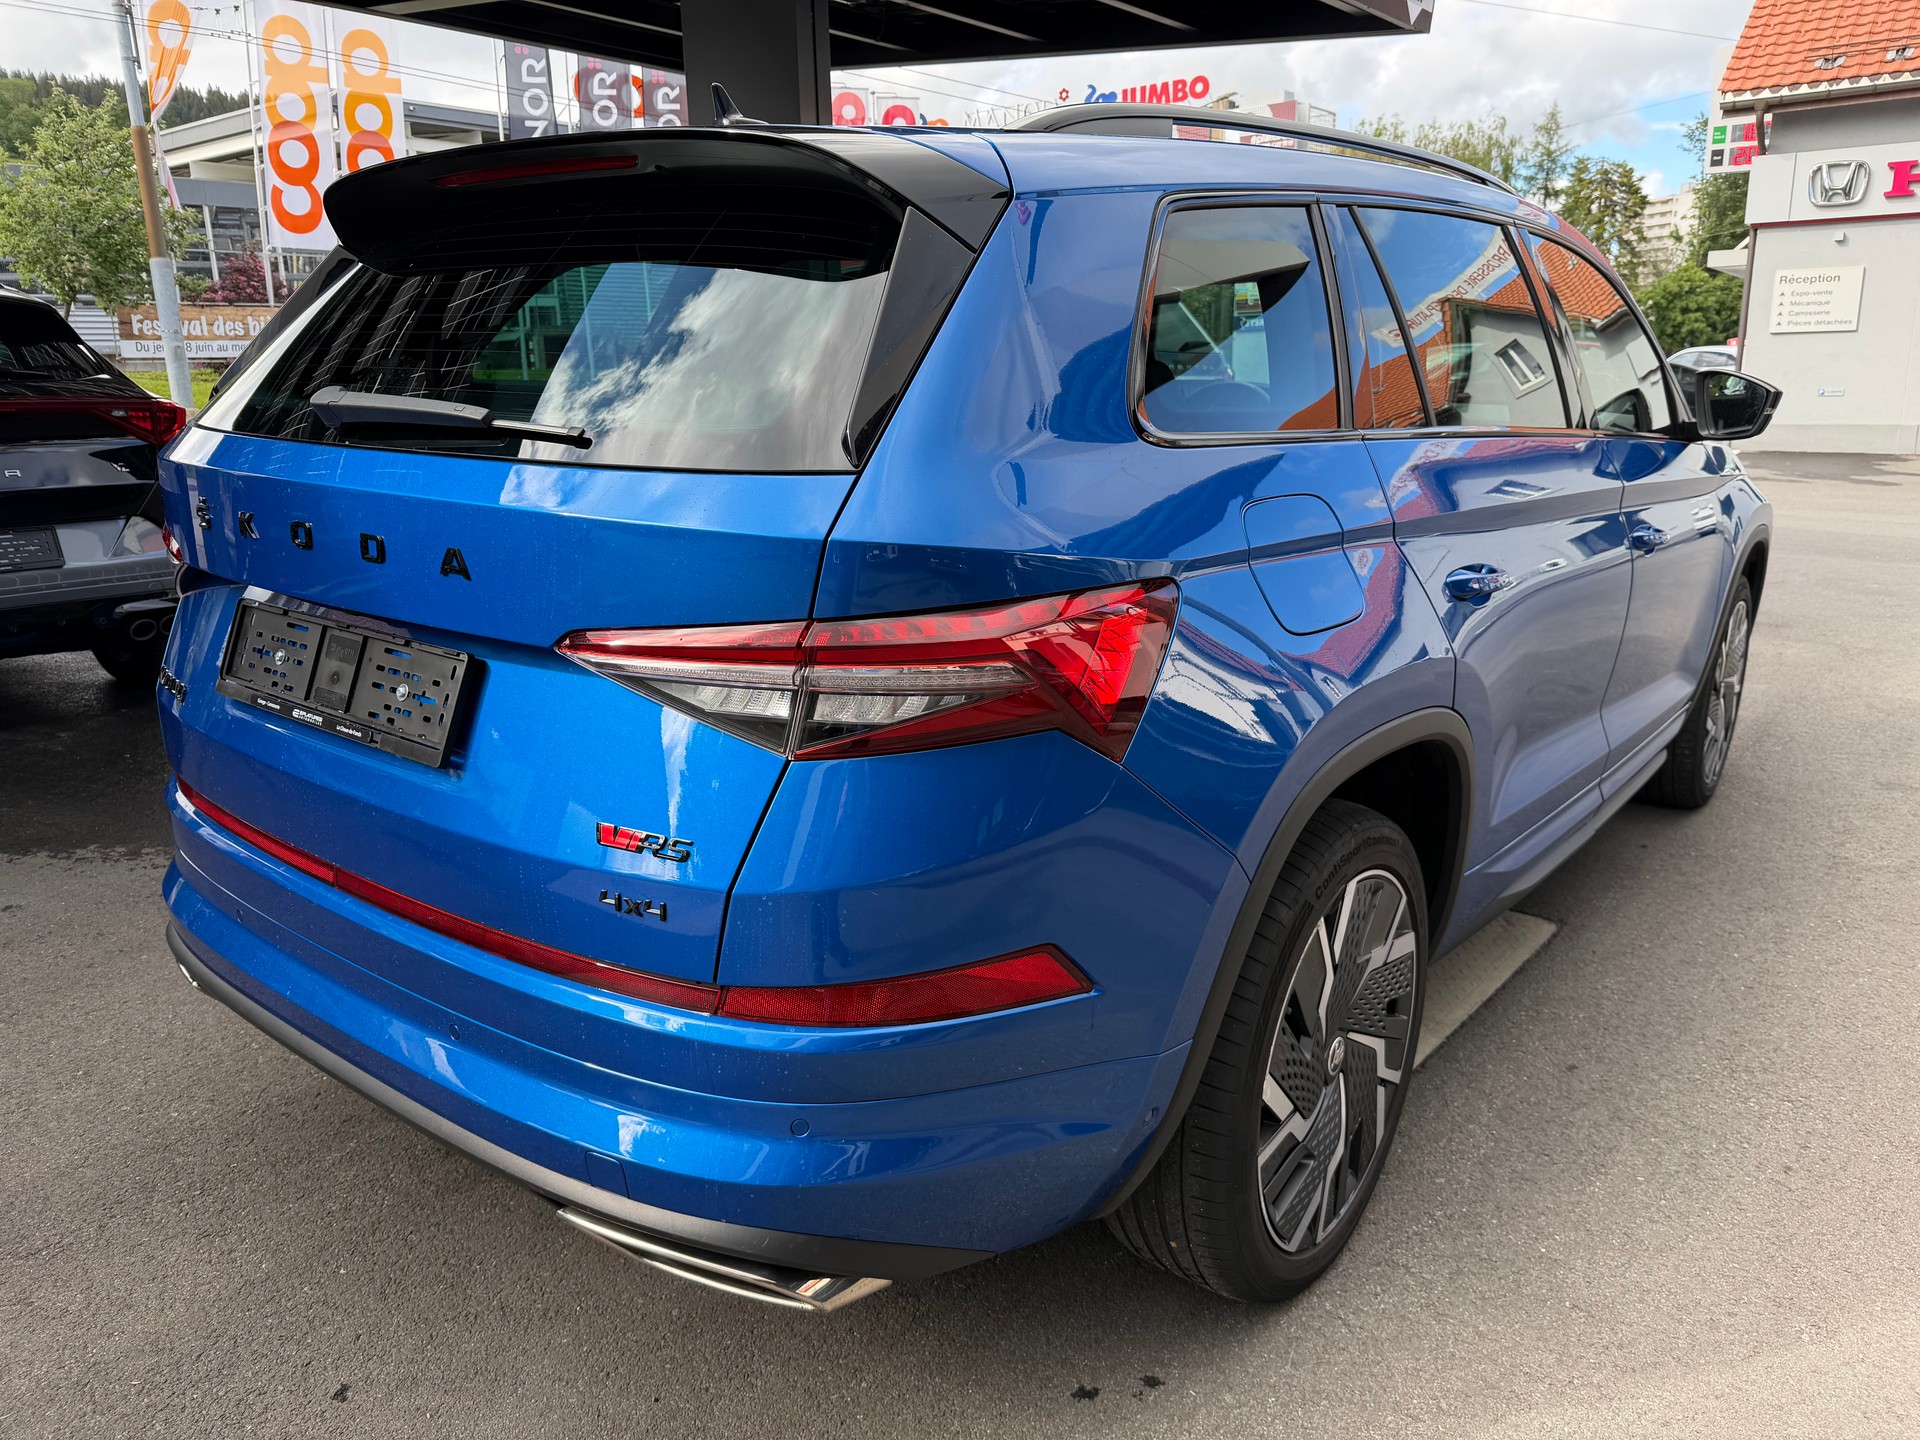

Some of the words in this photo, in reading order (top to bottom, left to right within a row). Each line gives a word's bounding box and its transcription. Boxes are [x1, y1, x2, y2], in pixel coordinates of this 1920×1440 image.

[262, 14, 330, 235] coop
[1779, 273, 1841, 285] Réception
[130, 314, 209, 337] Fesval
[212, 315, 245, 337] des
[247, 315, 271, 337] bi
[135, 341, 150, 352] Du
[195, 342, 214, 354] juin
[216, 344, 228, 352] au
